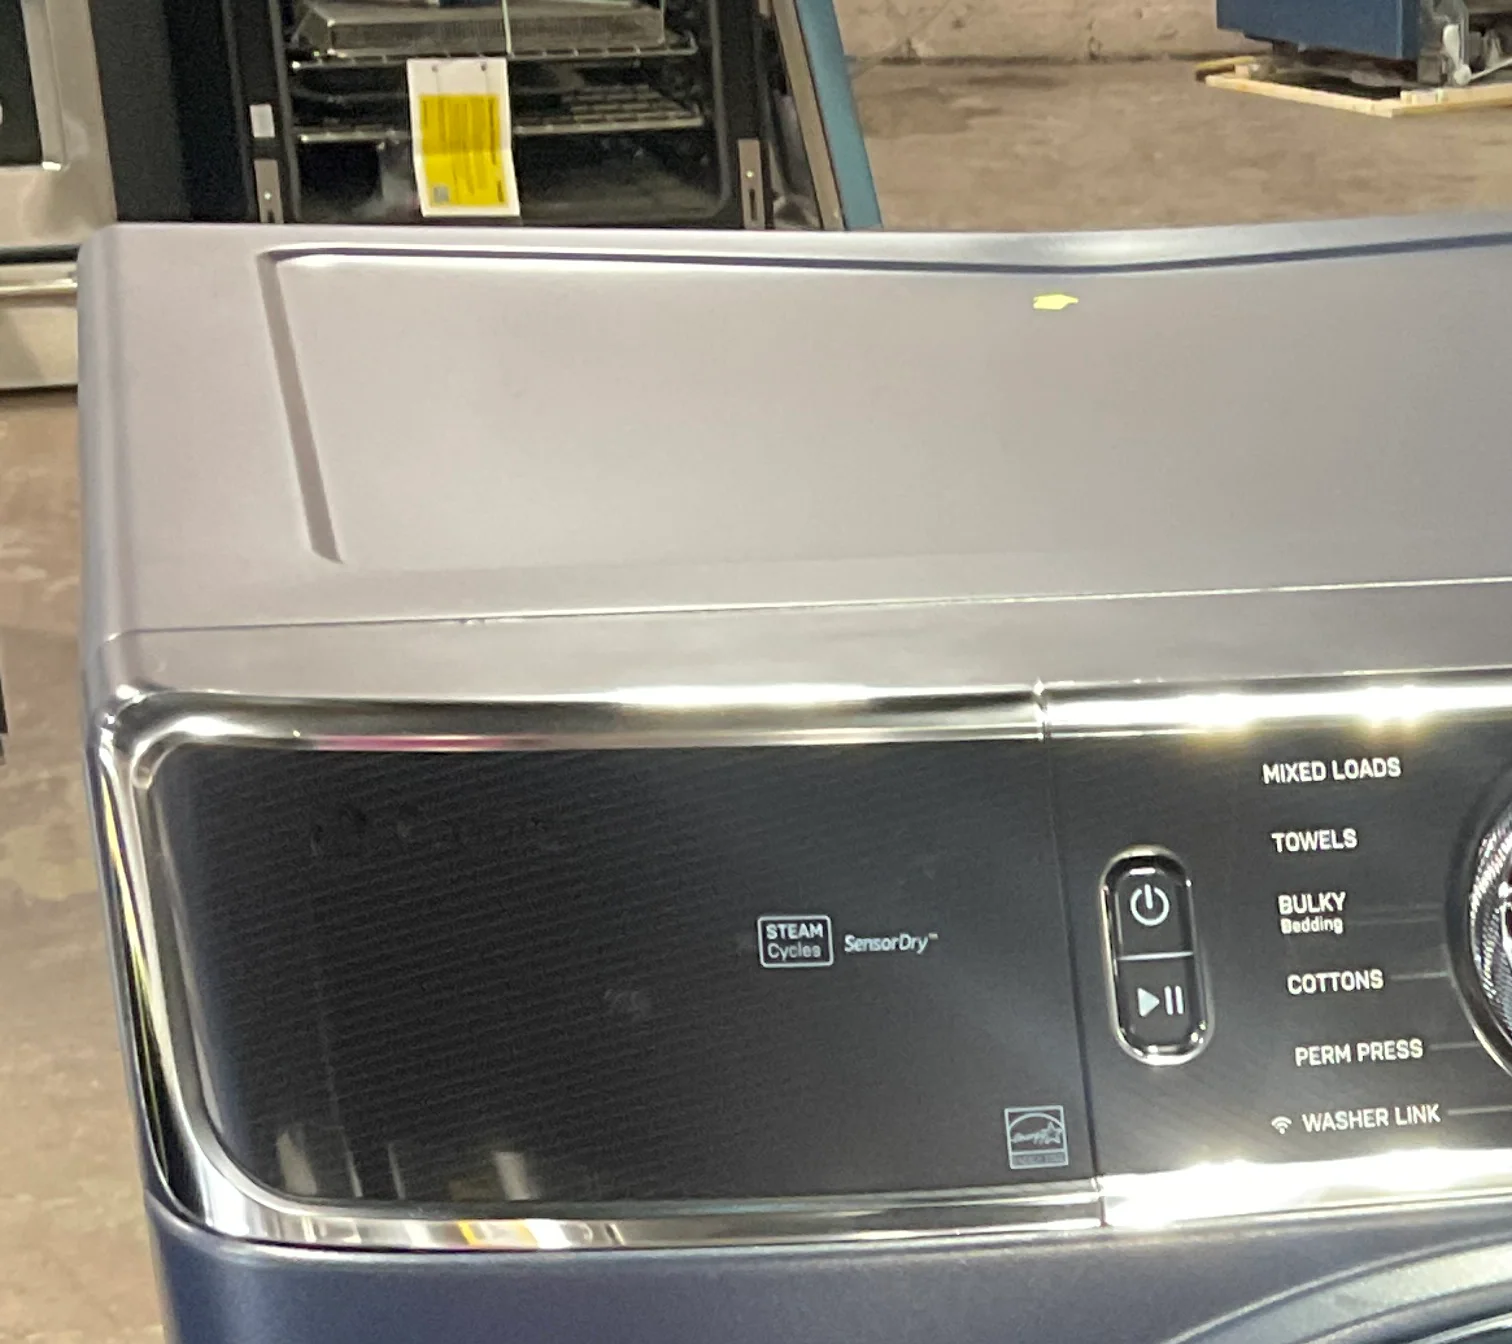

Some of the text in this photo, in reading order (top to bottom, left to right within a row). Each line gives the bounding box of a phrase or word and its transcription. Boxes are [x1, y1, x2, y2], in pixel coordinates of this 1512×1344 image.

[1262, 757, 1401, 784] MIXED LOADS
[1272, 828, 1358, 853] TOWELS
[1278, 892, 1347, 915] BULKY
[766, 923, 823, 940] STEAM
[1281, 916, 1343, 936] Bedding
[767, 942, 821, 962] Cycles
[1288, 969, 1384, 995] COTTONS
[1295, 1039, 1424, 1067] PERM PRESS
[1302, 1105, 1441, 1133] WASHER LINK
